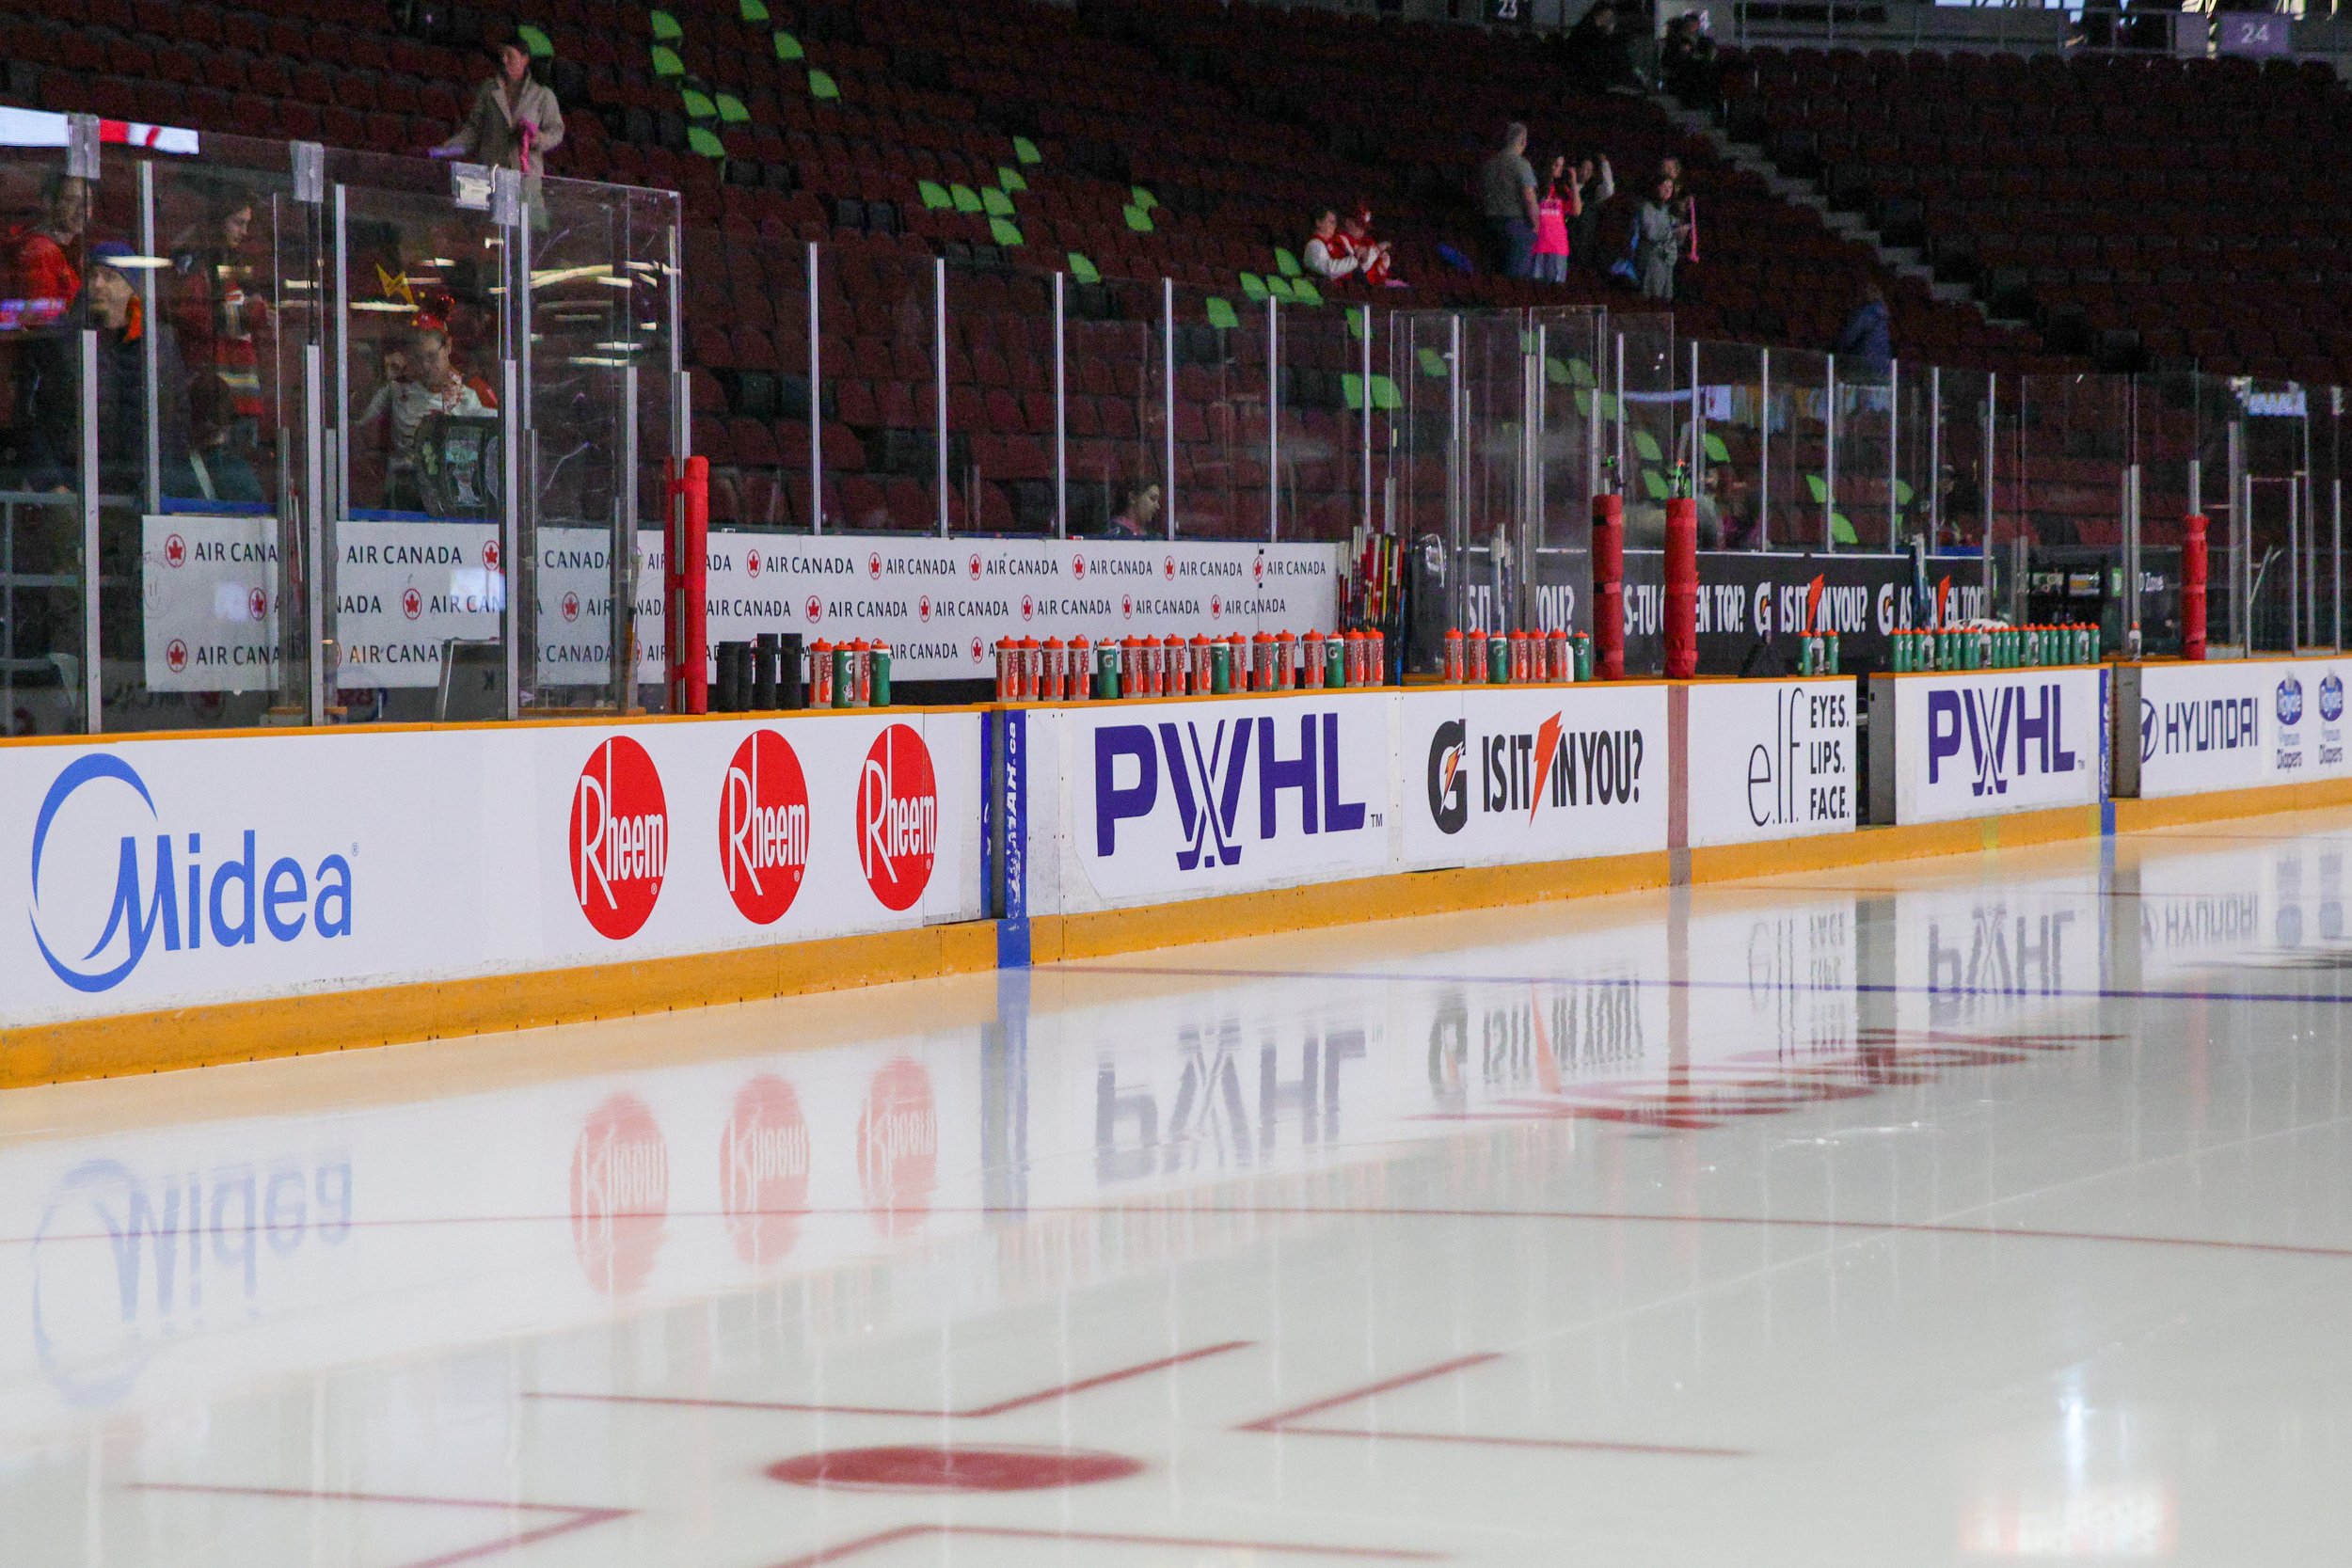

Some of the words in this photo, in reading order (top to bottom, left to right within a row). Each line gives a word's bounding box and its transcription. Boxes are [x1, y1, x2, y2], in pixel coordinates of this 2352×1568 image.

[2241, 24, 2268, 43] 24
[195, 543, 226, 561] AIR
[231, 543, 278, 562] CANA
[346, 546, 377, 562] AIR
[384, 546, 463, 564] CANADA
[766, 557, 788, 573] AIR
[792, 557, 854, 575] CANADA
[886, 559, 905, 575] AIR
[908, 559, 956, 575] CANADA
[986, 560, 1007, 575] AIR
[1009, 560, 1058, 575] CANADA
[1089, 561, 1108, 575] AIR
[1110, 561, 1153, 576] CANADA
[1180, 562, 1197, 576] AIR
[1200, 562, 1242, 577] CANADA
[1267, 562, 1283, 575] AIR
[1287, 561, 1327, 576] CANADA
[430, 595, 462, 613] AIR
[707, 600, 730, 616] AIR
[734, 600, 791, 617] CANADA
[828, 601, 852, 617] AIR
[857, 601, 908, 618] CANADA
[935, 601, 956, 617] AIR
[959, 600, 1009, 617] CANADA
[1038, 600, 1057, 615] AIR
[1061, 600, 1112, 615] CANADA
[1136, 600, 1152, 615] AIR
[1155, 600, 1200, 615] CANADA
[1225, 600, 1242, 615] AIR
[1244, 599, 1286, 614] CANADA
[1624, 584, 1657, 636] S-TU
[1715, 585, 1746, 633] TOI?
[1754, 581, 1772, 636] G
[1781, 586, 1795, 633] IS
[1795, 586, 1808, 632] IT
[1817, 586, 1832, 633] IN
[1833, 585, 1868, 633] YOU?
[1878, 582, 1894, 637] G
[197, 646, 228, 666] AIR
[233, 645, 278, 666] CANA
[350, 645, 380, 663] AIR
[387, 644, 439, 662] CANA
[889, 643, 907, 659] AIR
[909, 642, 958, 659] CANADA
[1810, 694, 1850, 728] EYES.
[2166, 697, 2258, 754] HYUNDAI
[1929, 685, 2075, 797] PWHL
[1810, 739, 1846, 775] LIPS.
[1428, 719, 1468, 834] G
[1483, 734, 1507, 813] IS
[1510, 734, 1533, 810] IT
[1552, 732, 1577, 807] IN
[1580, 729, 1643, 805] YOU?
[1095, 713, 1366, 871] PWHL
[866, 726, 935, 883] Rheem
[1810, 785, 1850, 820] FACE.
[581, 738, 664, 910] Rheem
[729, 732, 806, 896] Rheem
[84, 829, 353, 960] Midea
